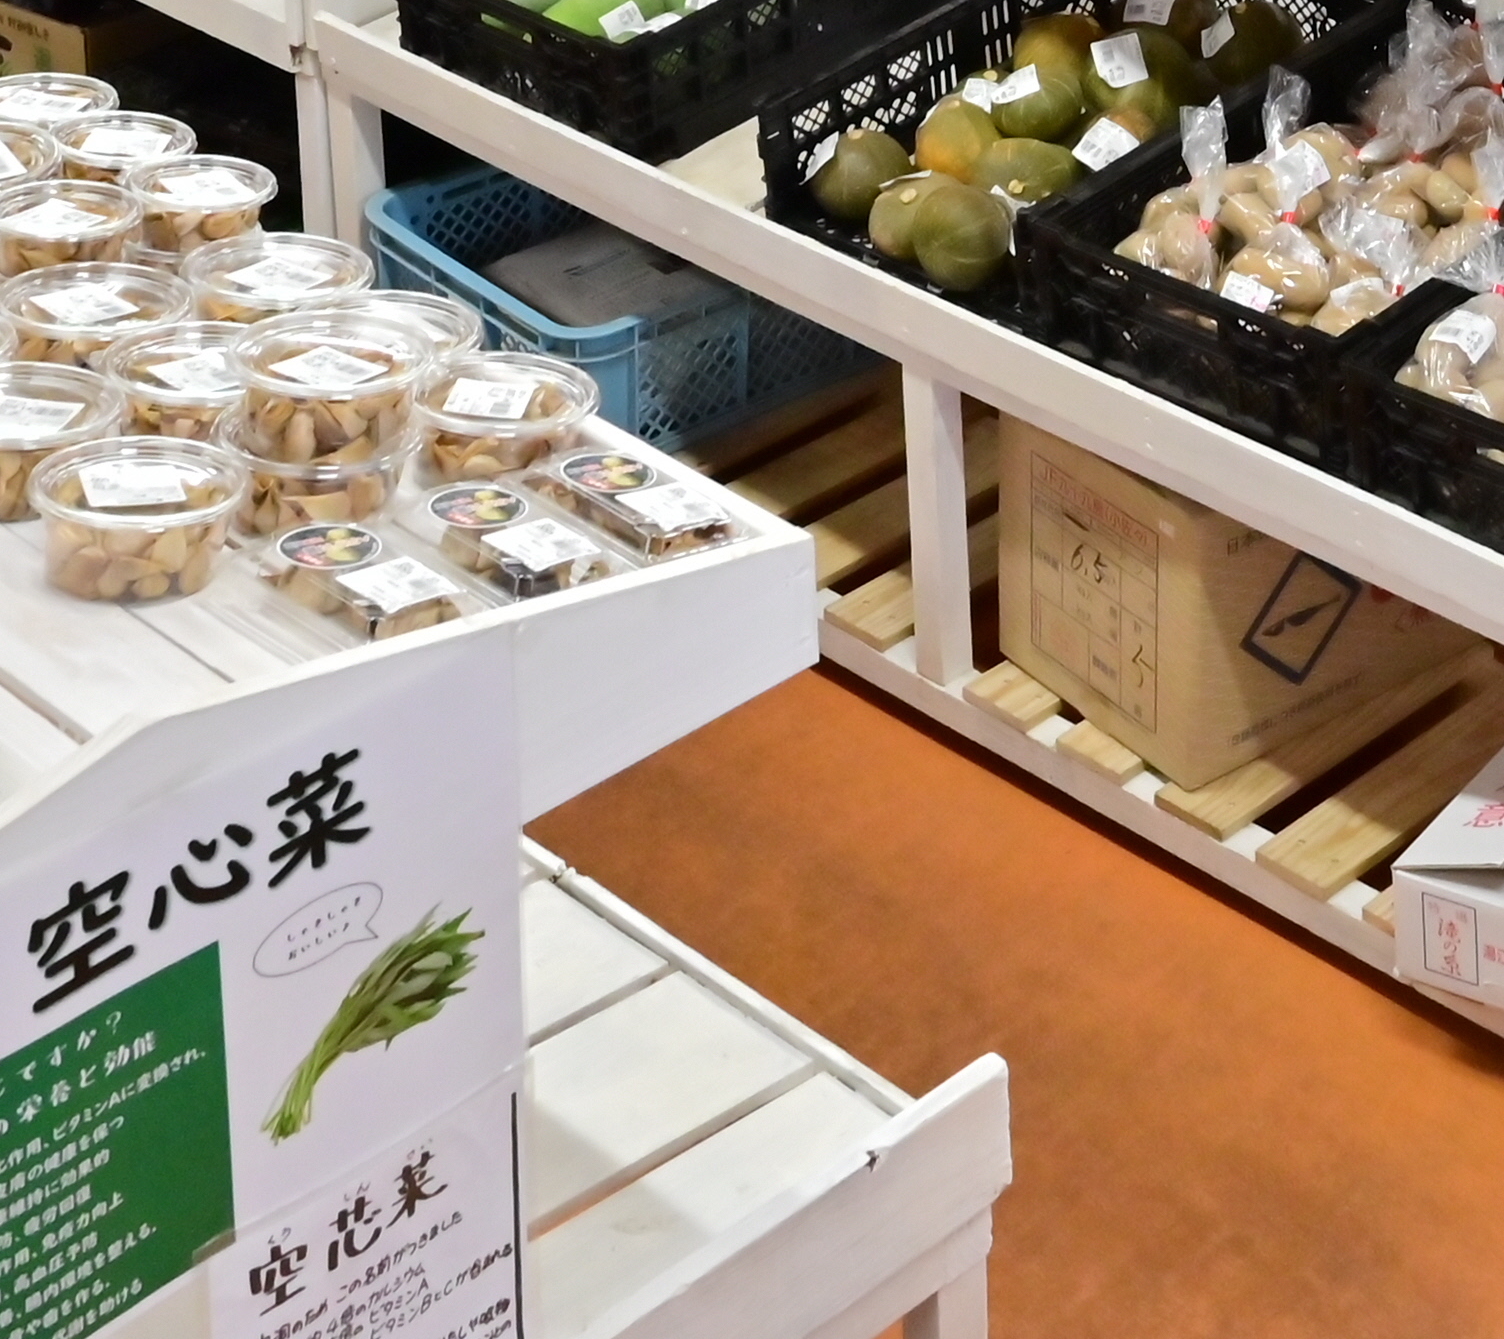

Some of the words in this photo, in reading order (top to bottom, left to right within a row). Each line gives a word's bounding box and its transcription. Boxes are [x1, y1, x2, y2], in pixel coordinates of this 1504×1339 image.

[27, 748, 371, 1014] 空心菜
[248, 1150, 449, 1317] 空芯菜
